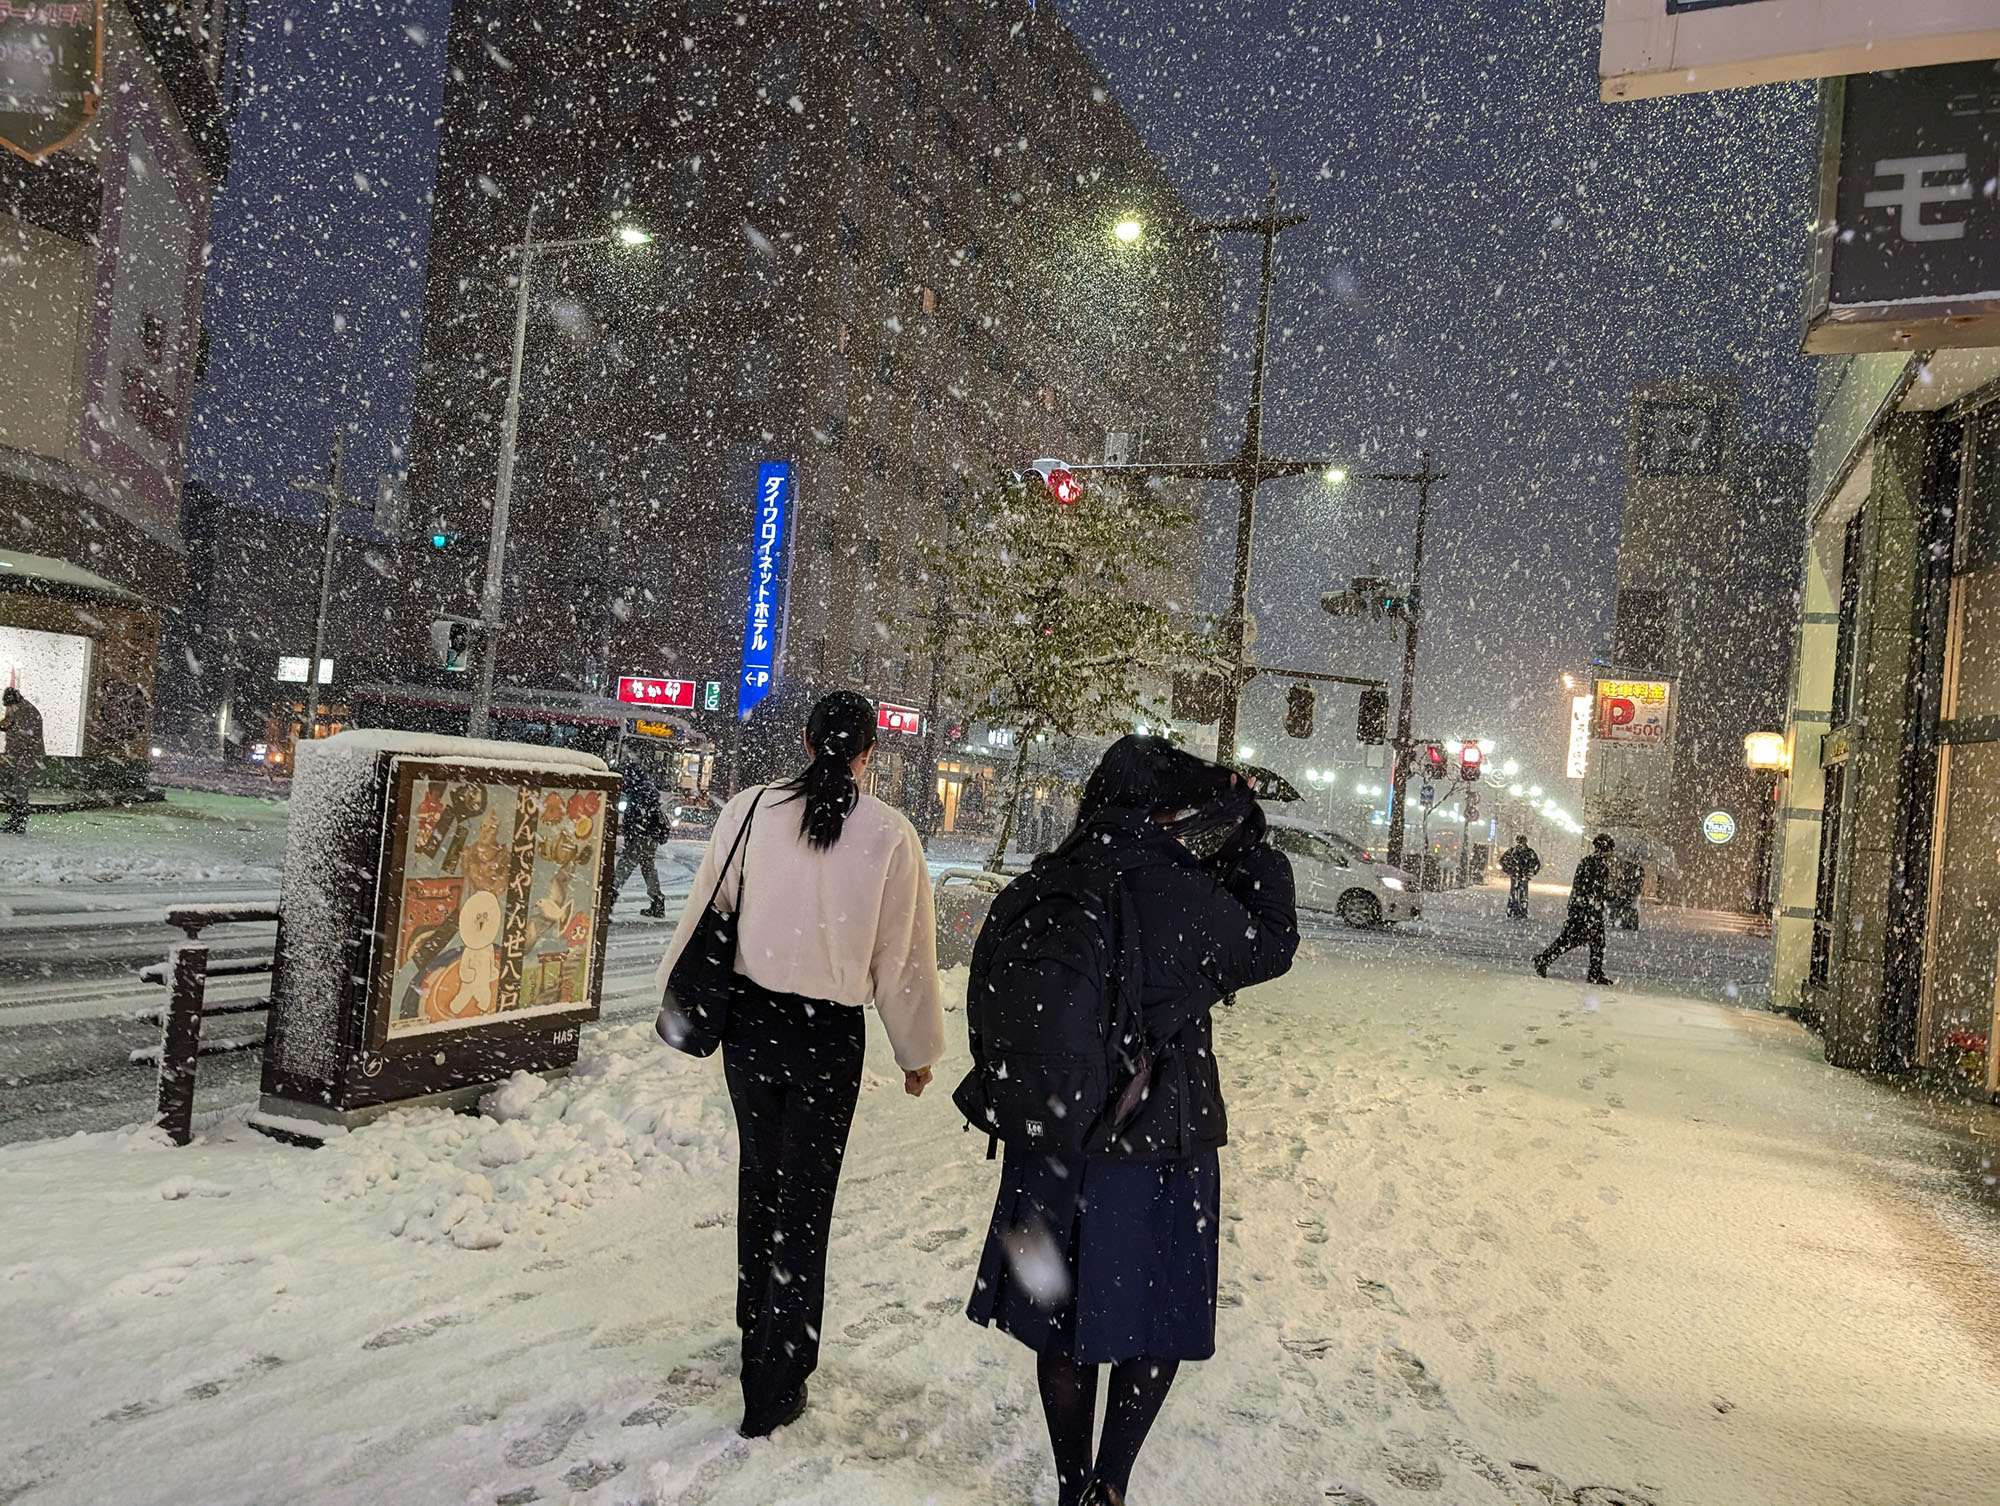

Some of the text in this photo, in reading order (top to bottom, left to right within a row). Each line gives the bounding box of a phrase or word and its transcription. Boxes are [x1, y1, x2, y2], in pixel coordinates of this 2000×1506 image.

[1864, 152, 2000, 243] モ
[751, 476, 785, 651] ダイワロイネットホテル
[632, 679, 681, 704] なか卯
[757, 671, 769, 688] P
[1602, 682, 1666, 699] 駐車料金
[1600, 697, 1636, 740] P
[499, 785, 540, 1012] おんでやんせ八戸
